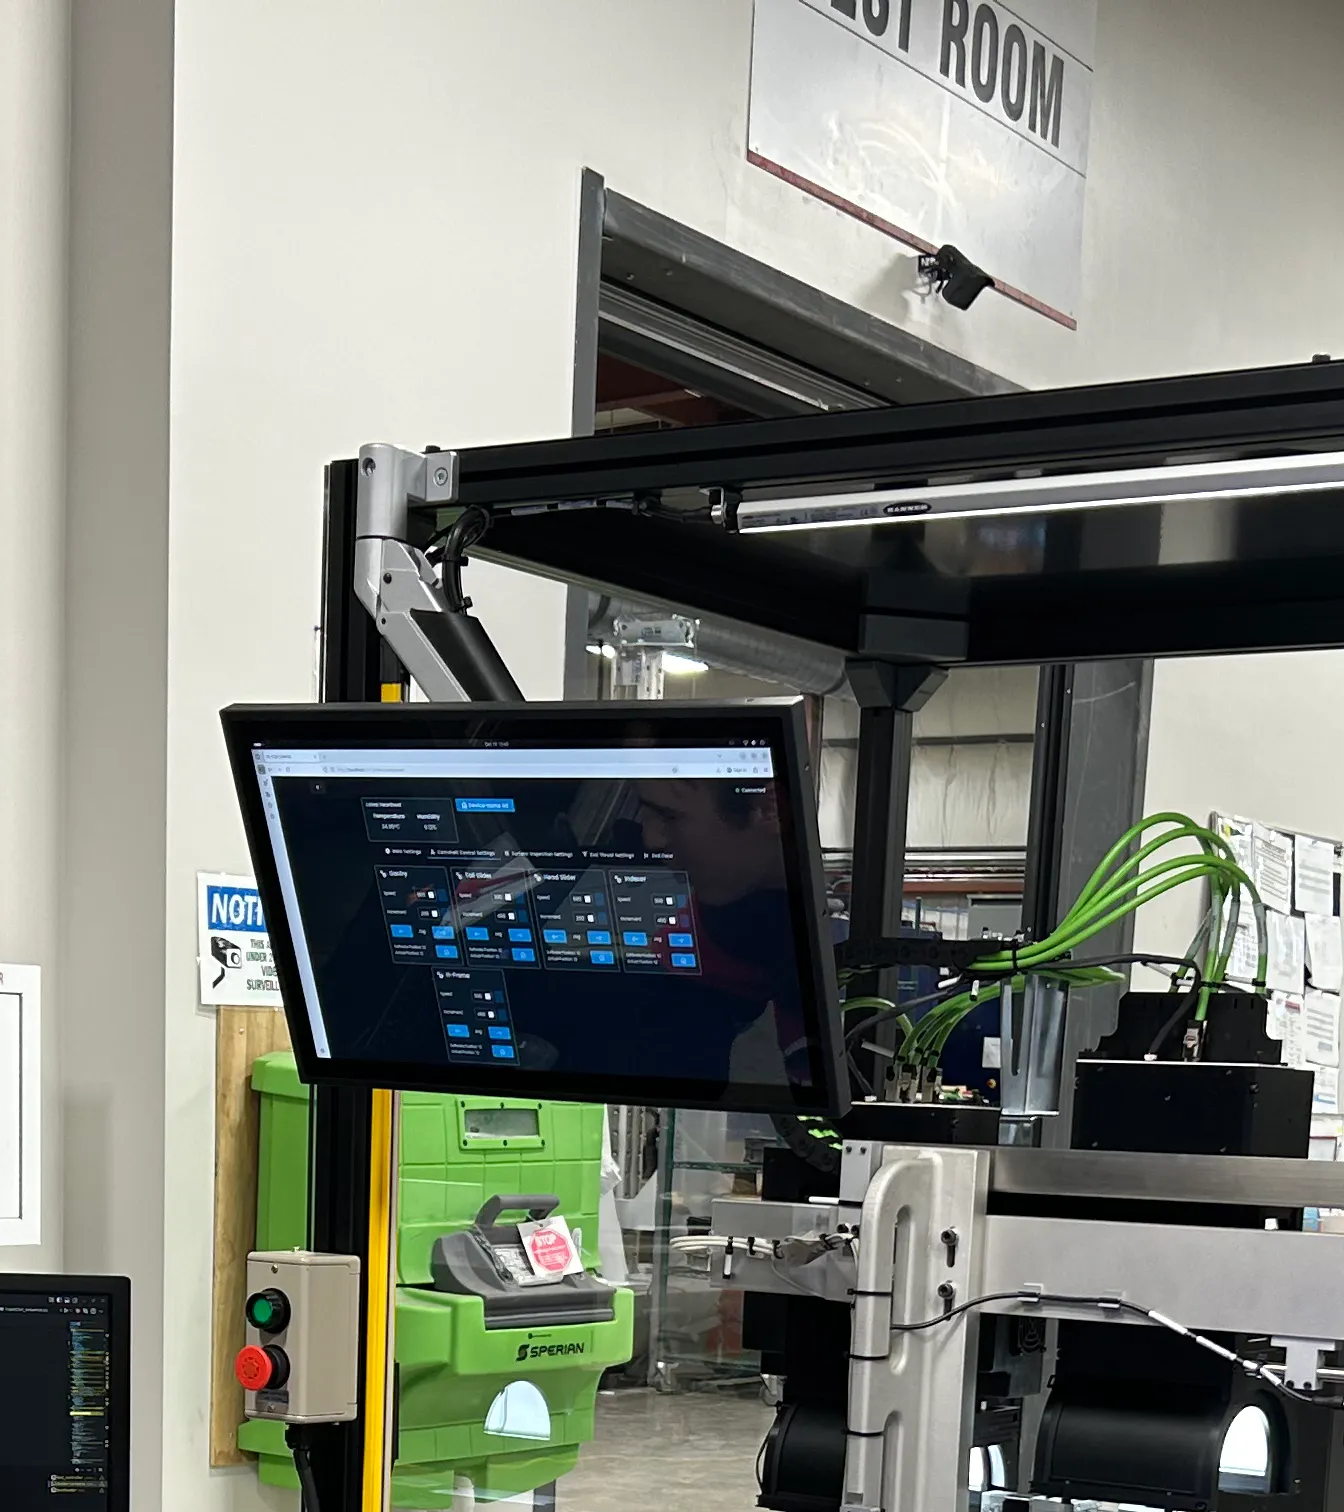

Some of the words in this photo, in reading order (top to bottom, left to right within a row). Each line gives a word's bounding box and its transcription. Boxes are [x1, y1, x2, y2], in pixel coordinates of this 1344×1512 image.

[940, 0, 1065, 149] ROOM
[211, 893, 263, 926] NOTI
[246, 979, 280, 991] SURVEILL
[534, 1233, 557, 1247] STOP
[530, 1342, 585, 1358] SPERIAN
